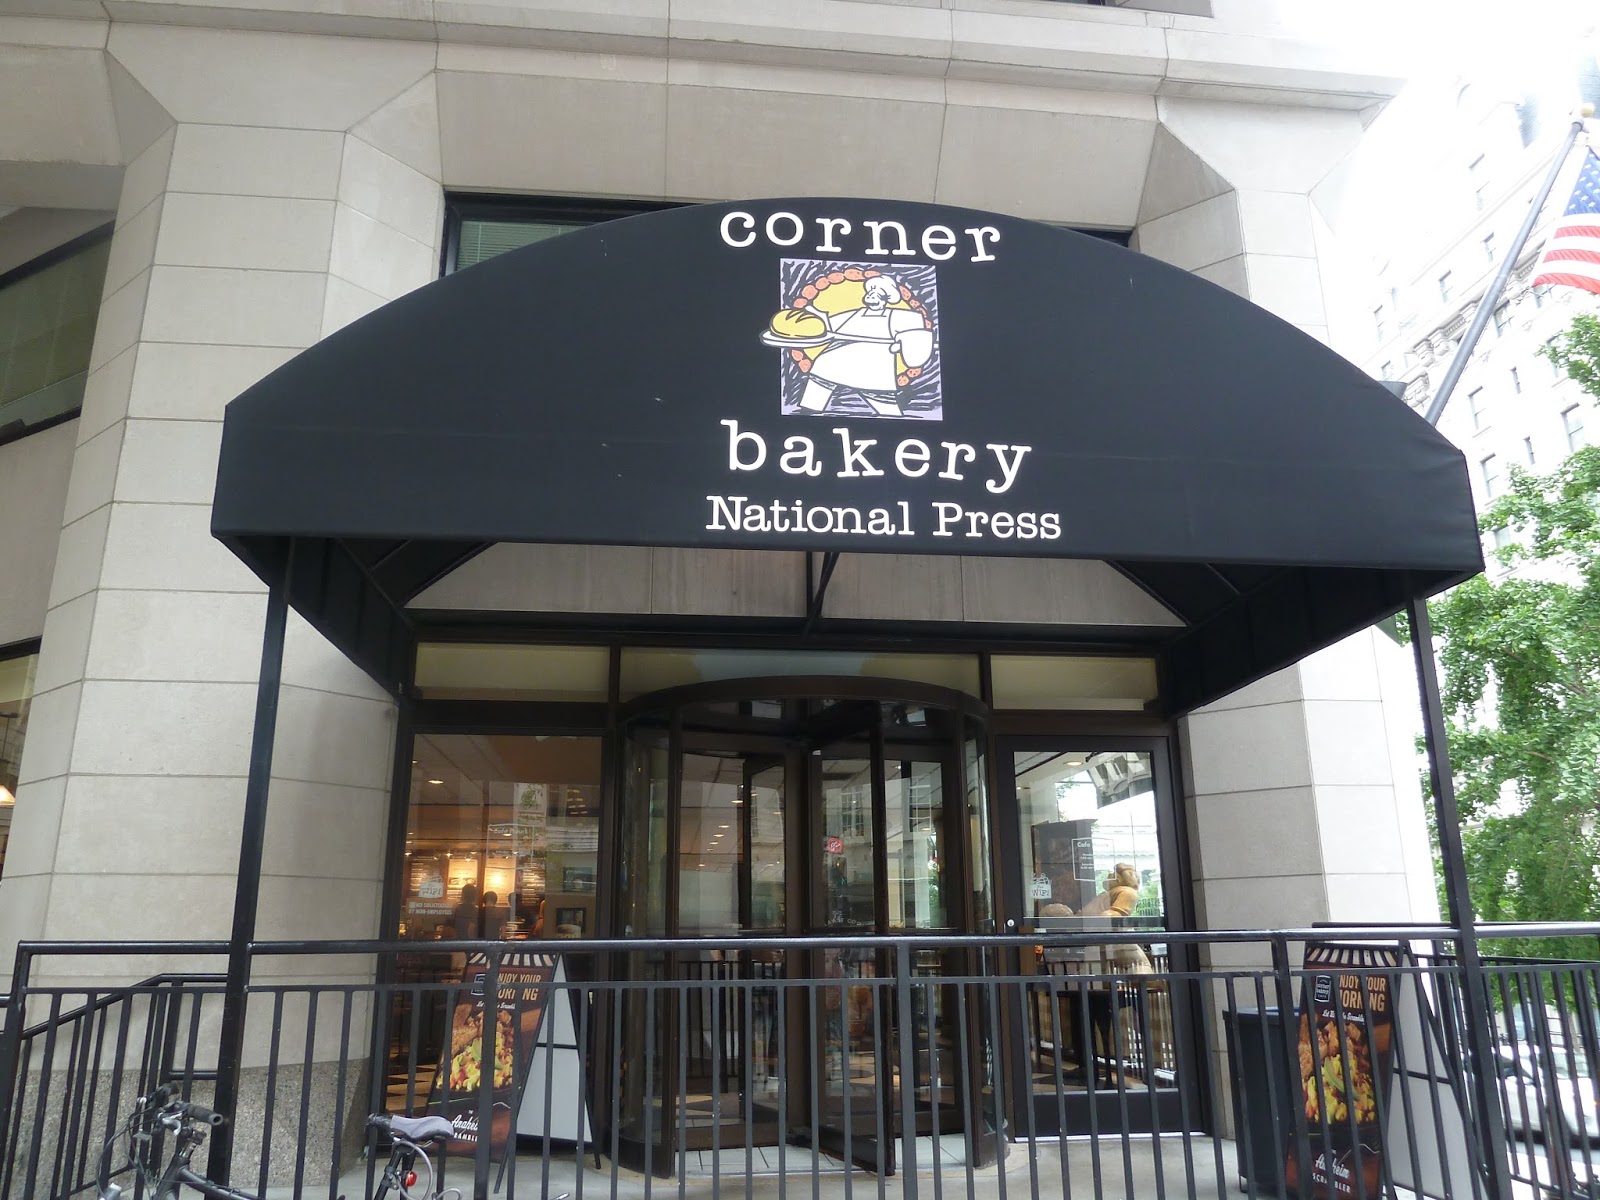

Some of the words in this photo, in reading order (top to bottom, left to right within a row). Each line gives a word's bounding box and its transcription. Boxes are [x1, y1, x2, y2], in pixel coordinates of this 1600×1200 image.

[719, 211, 1001, 263] corner
[720, 419, 1033, 494] bakery
[705, 495, 916, 537] National
[932, 501, 1062, 540] Press
[497, 973, 518, 984] NJOY
[1338, 974, 1360, 989] NJOY
[1365, 976, 1386, 992] OUR
